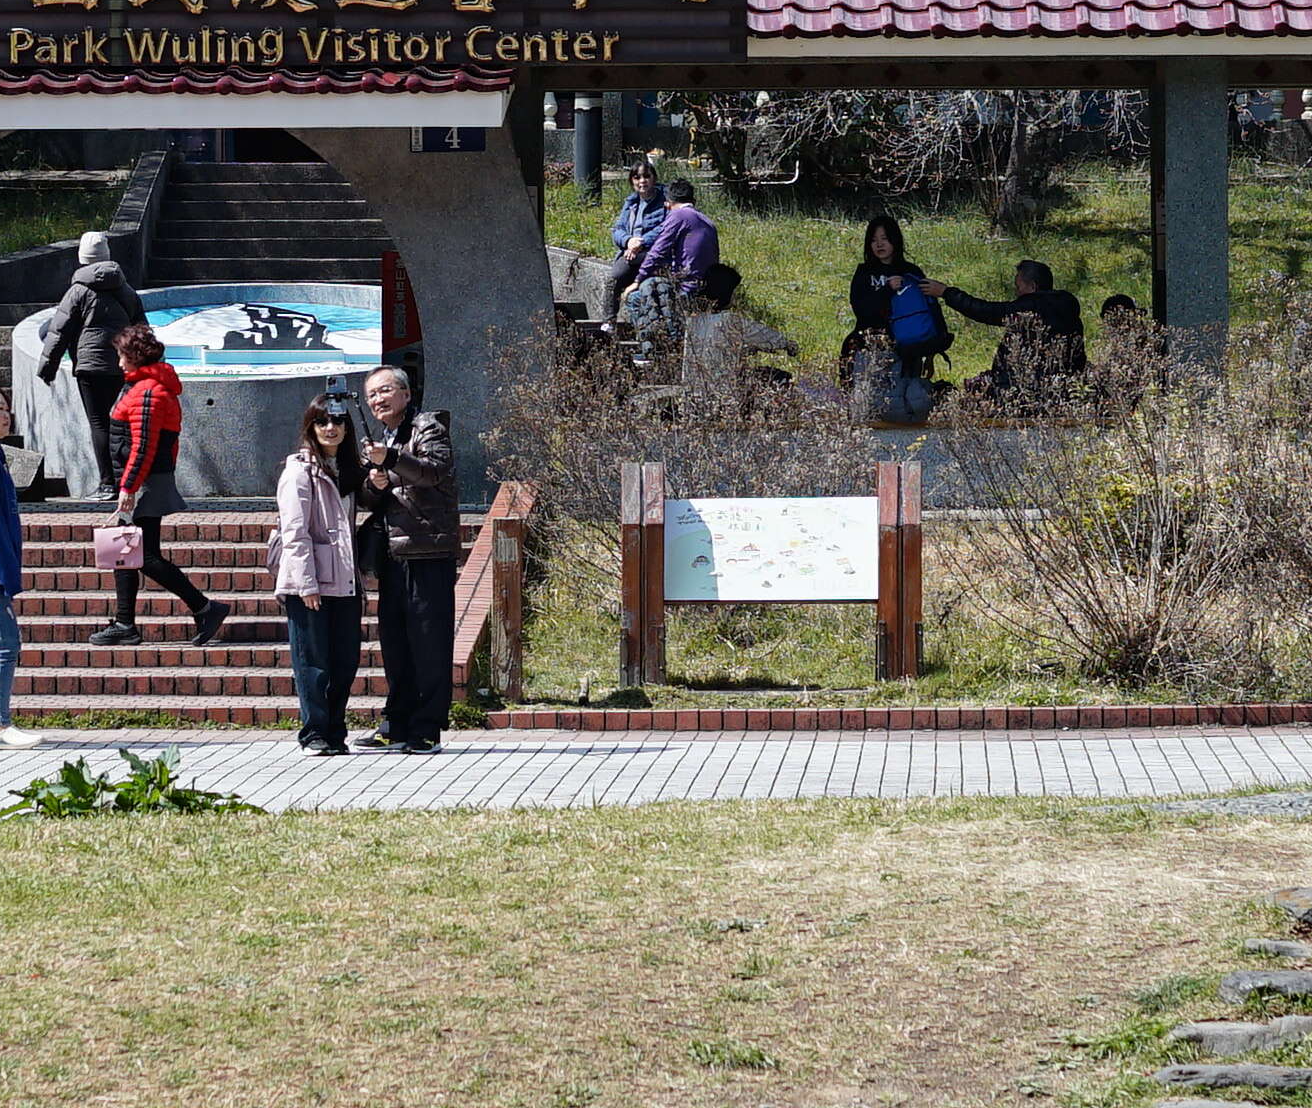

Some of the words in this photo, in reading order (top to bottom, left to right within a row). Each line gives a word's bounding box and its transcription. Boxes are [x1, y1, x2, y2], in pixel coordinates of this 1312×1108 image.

[9, 28, 109, 65] Park
[123, 26, 285, 66] Wuling
[298, 27, 453, 65] Visitor
[464, 26, 620, 64] Center
[445, 126, 461, 148] 4
